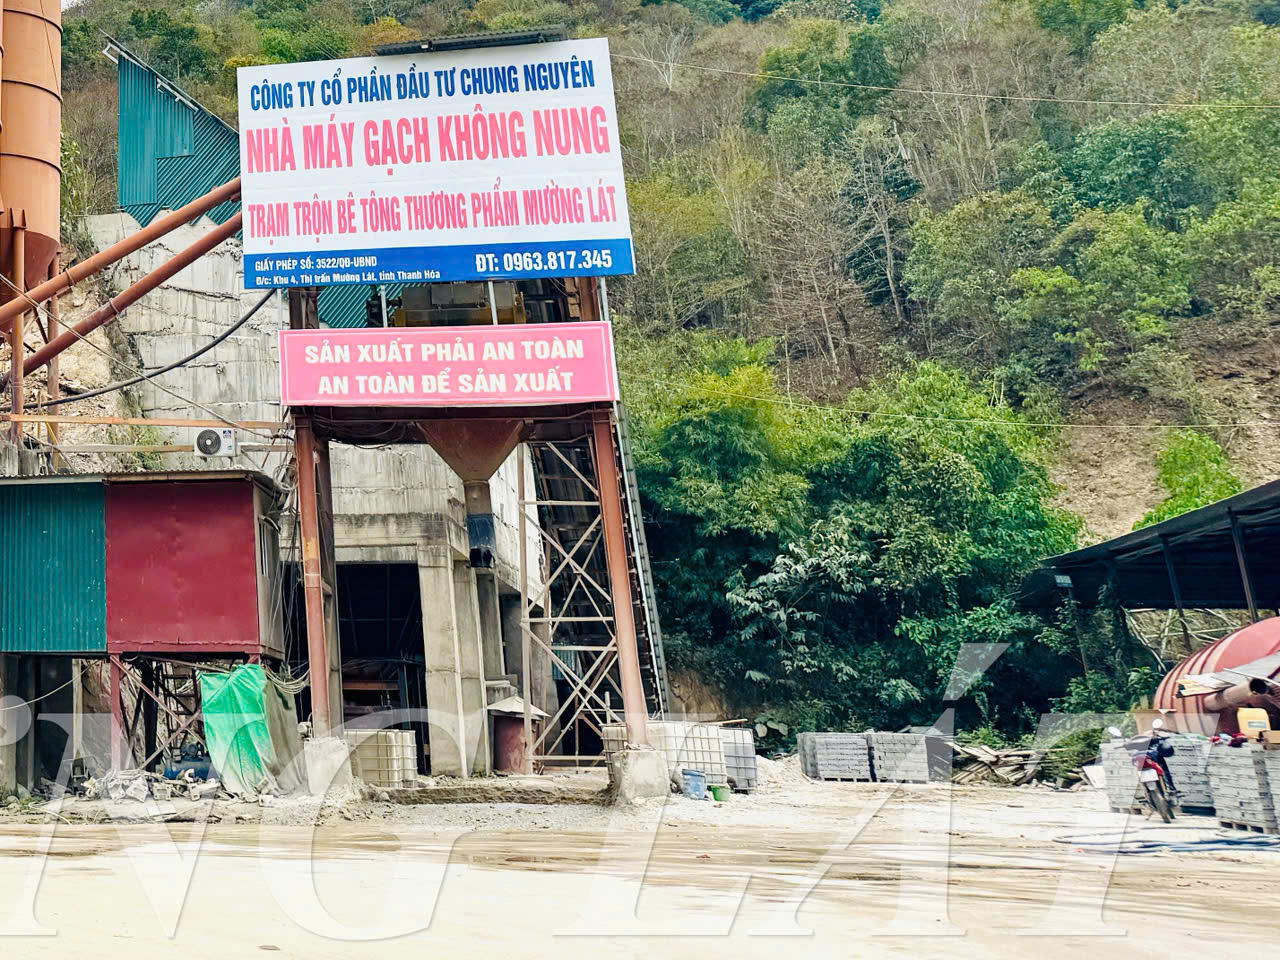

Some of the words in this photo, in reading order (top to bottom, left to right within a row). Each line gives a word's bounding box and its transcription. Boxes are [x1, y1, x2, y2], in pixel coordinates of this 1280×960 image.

[251, 79, 293, 110] CÔNG
[297, 81, 315, 107] TY
[321, 67, 342, 105] CỔ
[347, 66, 392, 103] PHẦN
[396, 63, 430, 100] ĐẦU
[434, 67, 456, 97] TƯ
[460, 65, 519, 95] CHUNG
[524, 55, 595, 91] NGUYÊN
[246, 117, 296, 173] NHÀ
[302, 113, 354, 170] MÁY
[363, 117, 431, 176] GẠCH
[437, 104, 527, 162] KHÔNG
[532, 105, 610, 157] NUNG
[248, 202, 290, 245] TRẠM
[293, 193, 333, 243] TRỘN
[337, 192, 357, 234] BÊ
[360, 190, 401, 233] TÔNG
[404, 190, 468, 231] THƯƠNG
[471, 176, 519, 228] PHẨM
[523, 179, 585, 225] MƯỜNG
[587, 178, 617, 223] LÁT
[255, 257, 274, 272] GIẤY
[276, 257, 298, 271] PHÉP
[300, 255, 314, 270] SỐ:
[476, 253, 499, 273] ĐT:
[503, 249, 612, 272] 0963.817.345
[273, 275, 289, 285] Khu
[300, 274, 313, 286] Thị
[314, 272, 331, 283] trấn
[333, 272, 360, 283] Mường
[379, 270, 395, 281] tỉnh
[397, 270, 422, 281] Thanh
[424, 269, 440, 280] Hóa
[305, 339, 350, 363] SẢN
[358, 337, 413, 362] XUẤT
[421, 337, 474, 362] PHẢI
[482, 342, 515, 361] AN
[521, 337, 584, 360] TOÀN
[319, 376, 349, 394] AN
[356, 372, 414, 394] TOÀN
[421, 367, 451, 393] ĐỂ
[458, 367, 506, 393] SẢN
[515, 365, 573, 391] XUẤT
